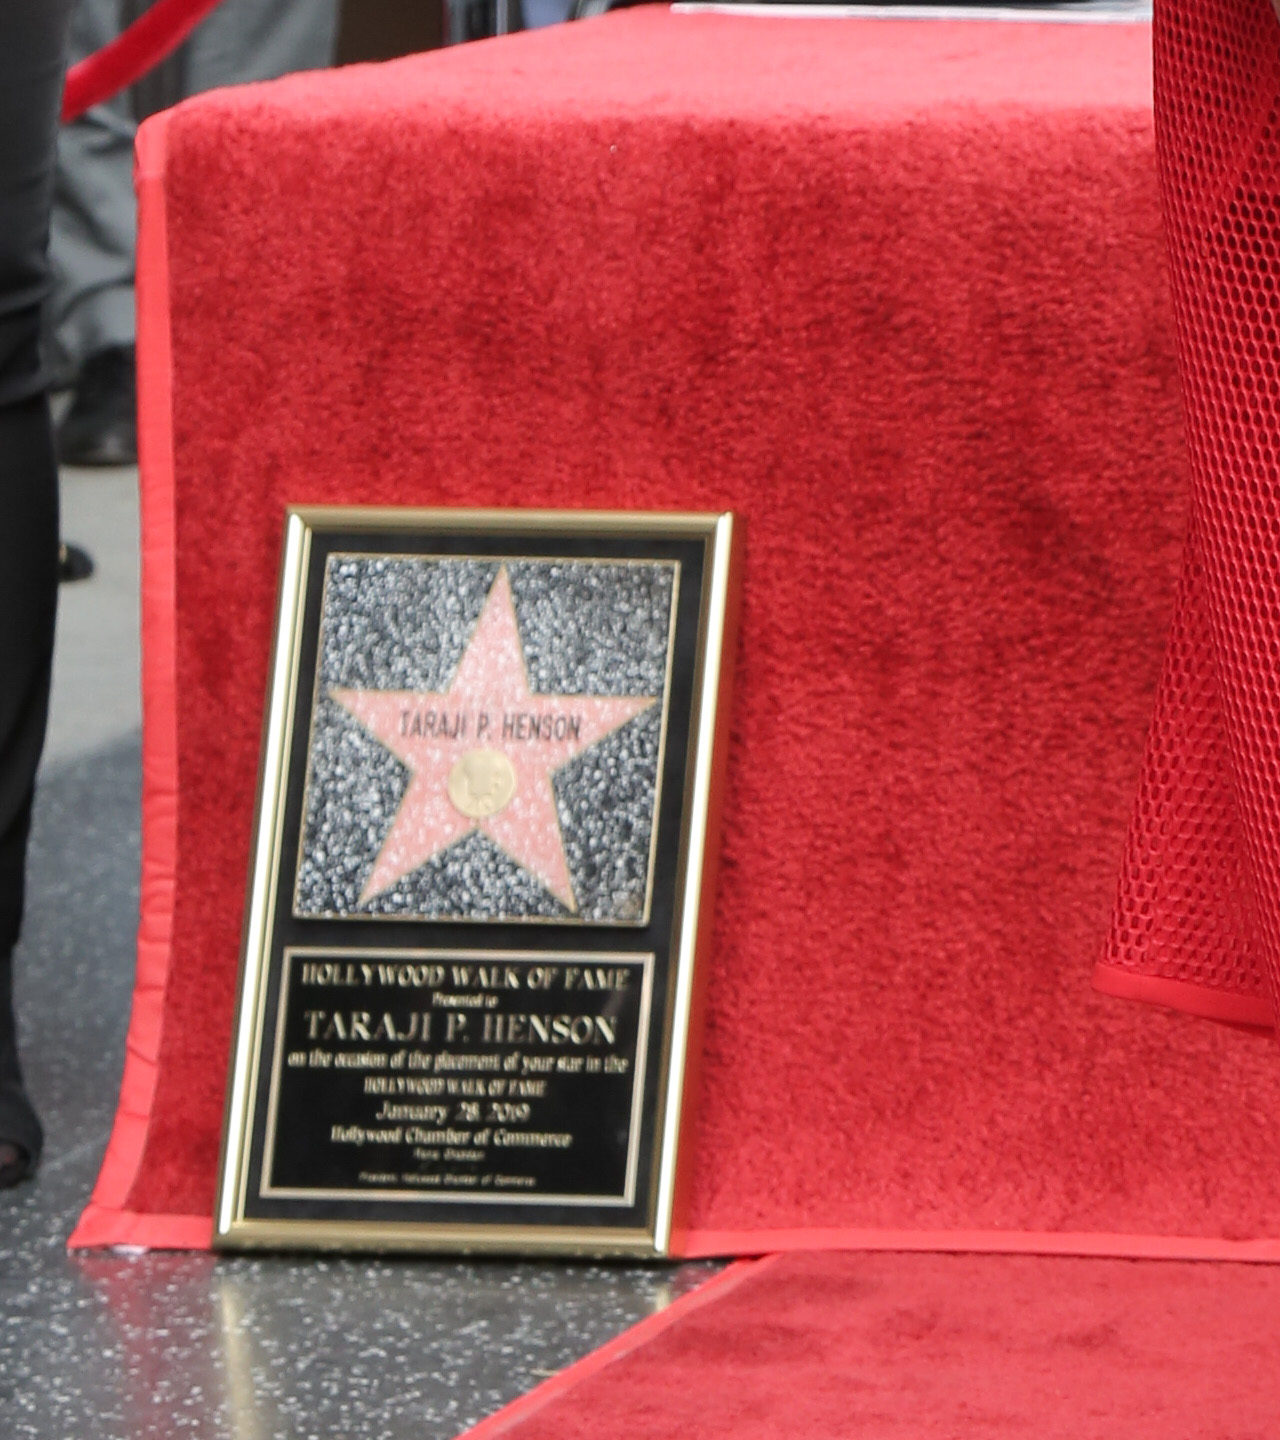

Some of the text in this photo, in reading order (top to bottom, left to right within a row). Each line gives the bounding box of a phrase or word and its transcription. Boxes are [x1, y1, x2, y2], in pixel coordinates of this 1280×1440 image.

[400, 710, 582, 741] TARAJI P. HENSON
[302, 963, 631, 991] HOLLYWOOD WALK OF FAME
[432, 992, 498, 1008] Presented to
[304, 1010, 617, 1045] TARAJI P. HENSON
[288, 1049, 629, 1075] on the occasion of the placement of your star in the
[364, 1076, 547, 1098] HOLLYWOOD WALK OF FAME
[375, 1100, 448, 1125] January
[484, 1102, 532, 1124] 2019
[331, 1124, 573, 1148] Hollywood Chamber of Commerce
